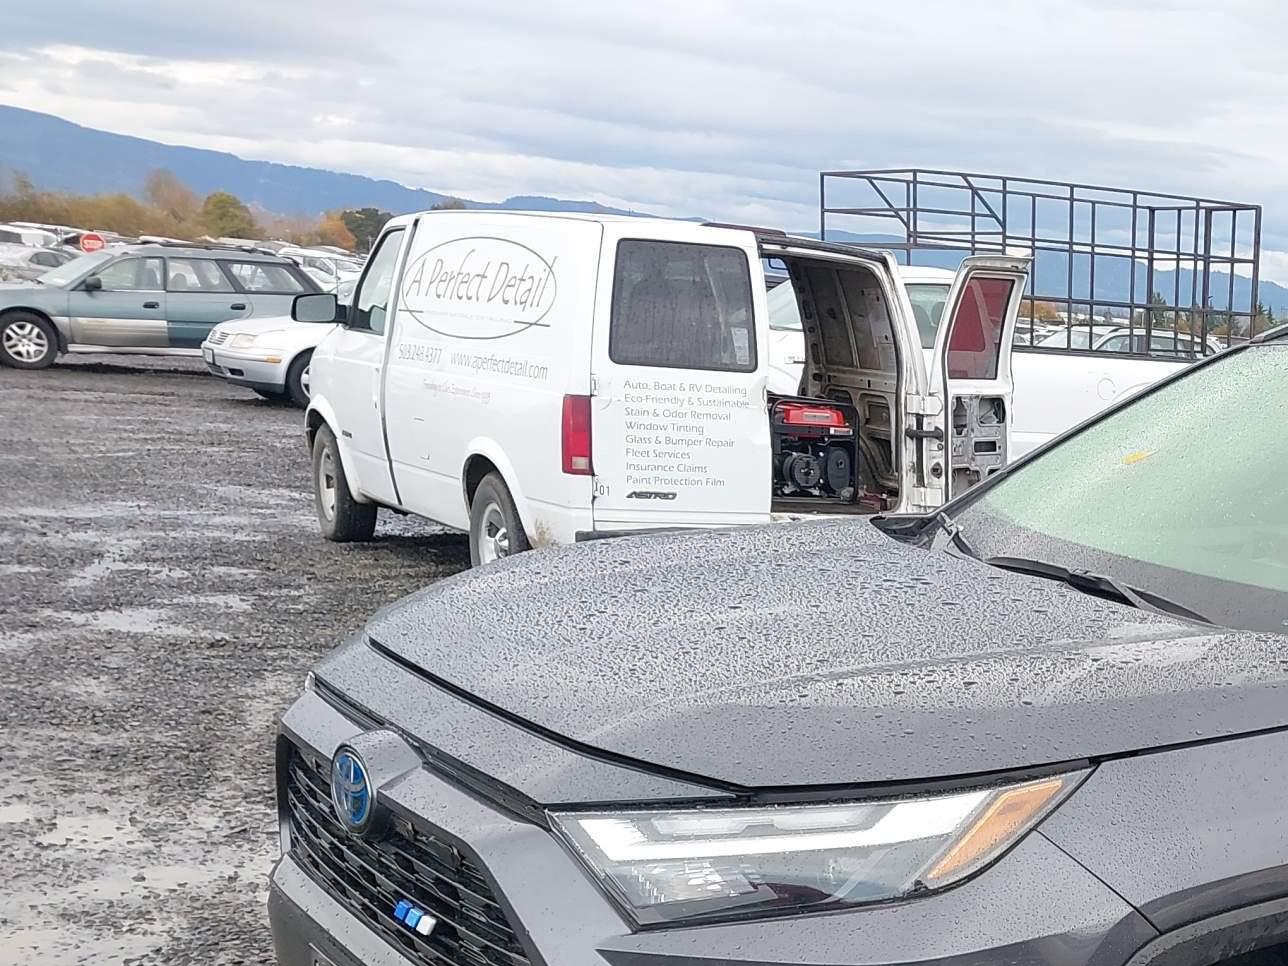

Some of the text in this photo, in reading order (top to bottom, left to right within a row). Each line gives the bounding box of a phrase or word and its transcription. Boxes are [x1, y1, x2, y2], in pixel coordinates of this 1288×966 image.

[405, 248, 557, 312] A Perfect Detail
[450, 352, 548, 380] www.aperfectdetail.com
[653, 381, 677, 393] Boat
[679, 382, 686, 392] &
[688, 383, 703, 393] RV
[705, 384, 747, 398] Detailing
[624, 393, 750, 409] Eco-Friendly & Sustainable
[624, 406, 731, 421] Stain & Odor Removal
[625, 420, 705, 435] Window Tinting
[625, 434, 735, 449] Glass & Bumper Repair
[625, 447, 691, 460] Fleet Services
[625, 461, 709, 474] Insurance Claims
[626, 474, 726, 488] Paint Protection Film
[626, 490, 678, 501] ASTRO
